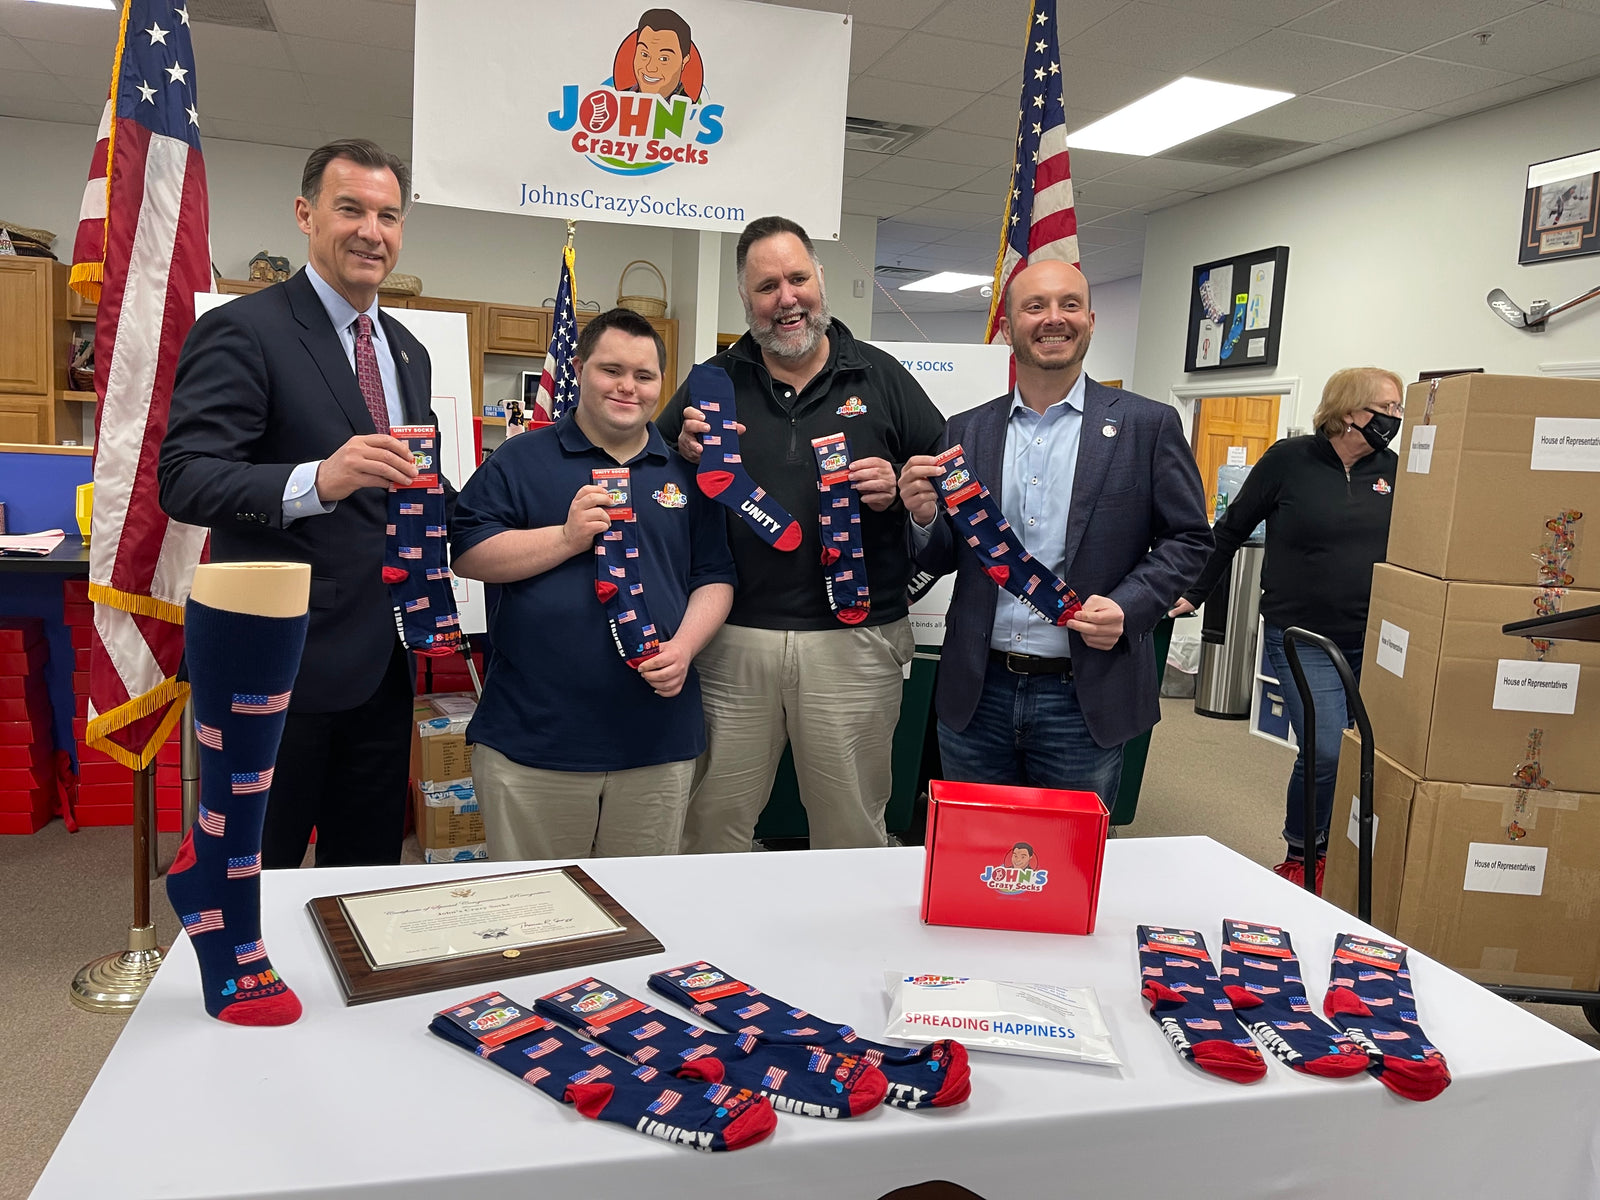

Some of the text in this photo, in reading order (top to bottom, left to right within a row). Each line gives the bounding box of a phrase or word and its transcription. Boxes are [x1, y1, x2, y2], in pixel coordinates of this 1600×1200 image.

[548, 85, 725, 145] JOHN'S
[571, 131, 709, 165] Crazy Socks
[520, 183, 746, 222] JohnsCrazySocks.com
[916, 360, 954, 372] SOCKS
[1540, 435, 1558, 445] House
[1559, 435, 1565, 445] of
[741, 500, 782, 533] UNITY
[1503, 677, 1568, 690] House of Representatives
[1474, 859, 1536, 872] House of Representatives
[980, 866, 1047, 885] JOHN'S
[989, 881, 1041, 891] Crazy Socks
[234, 985, 277, 1000] Crazy
[905, 1012, 1076, 1039] SPREADING HAPPINESS
[887, 1082, 928, 1102] ITY
[636, 1115, 714, 1147] UNITY
